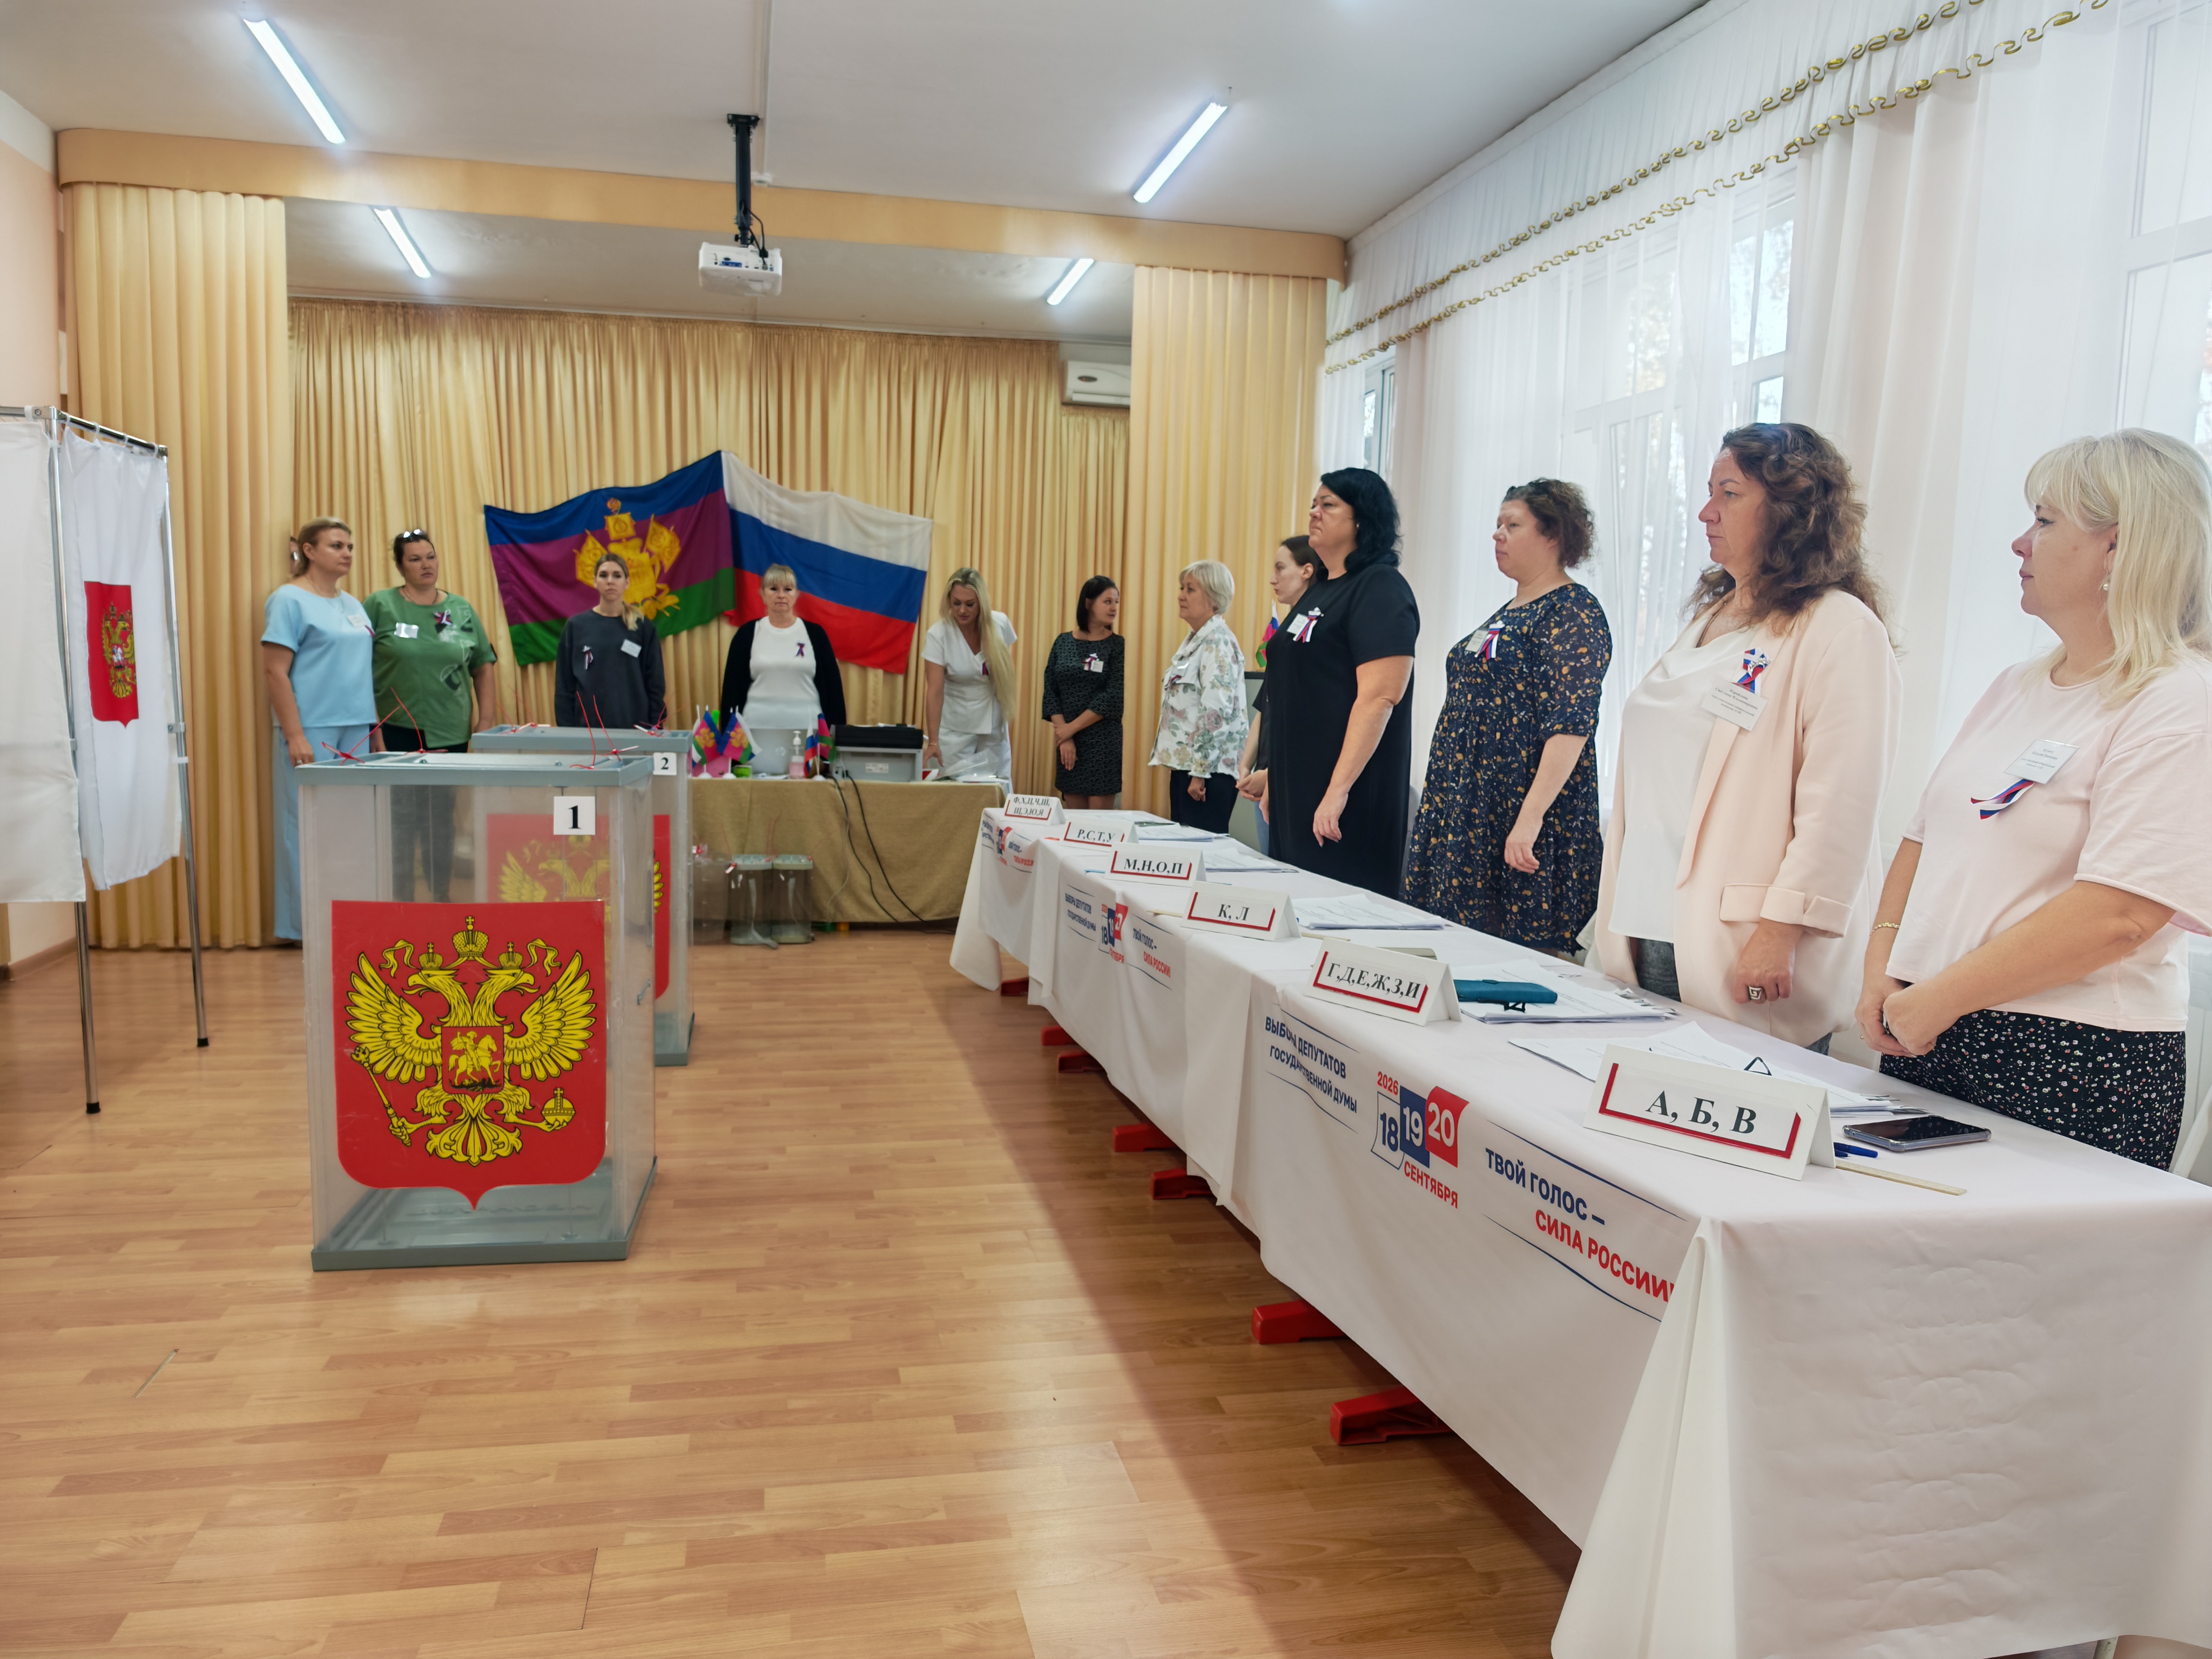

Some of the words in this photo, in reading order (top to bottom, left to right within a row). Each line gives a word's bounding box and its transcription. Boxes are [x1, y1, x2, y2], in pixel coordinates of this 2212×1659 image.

[660, 757, 669, 770] 2
[568, 805, 582, 829] 1
[1077, 829, 1116, 843] Р,С,Т,У
[1124, 859, 1183, 875] М,Н,О,П
[1217, 904, 1231, 921] К,
[1236, 907, 1250, 921] Л
[1102, 925, 1108, 945] 18
[1327, 963, 1421, 999] Г,Д,Е,Ж,З,И
[1298, 1037, 1346, 1080] ДЕПУТАТОВ
[1333, 1087, 1357, 1114] ДУМЫ
[1377, 1071, 1399, 1096] 2026
[1402, 1106, 1423, 1147] 19
[1428, 1102, 1455, 1148] 20
[1645, 1090, 1678, 1123] А,
[1688, 1097, 1719, 1133] Б,
[1729, 1105, 1757, 1134] В
[1380, 1112, 1398, 1152] 18
[1404, 1161, 1458, 1209] СЕНТЯБРЯ
[1485, 1147, 1526, 1189] ТВОЙ
[1530, 1172, 1587, 1220] ГОЛОС
[1535, 1209, 1583, 1255] СИЛА
